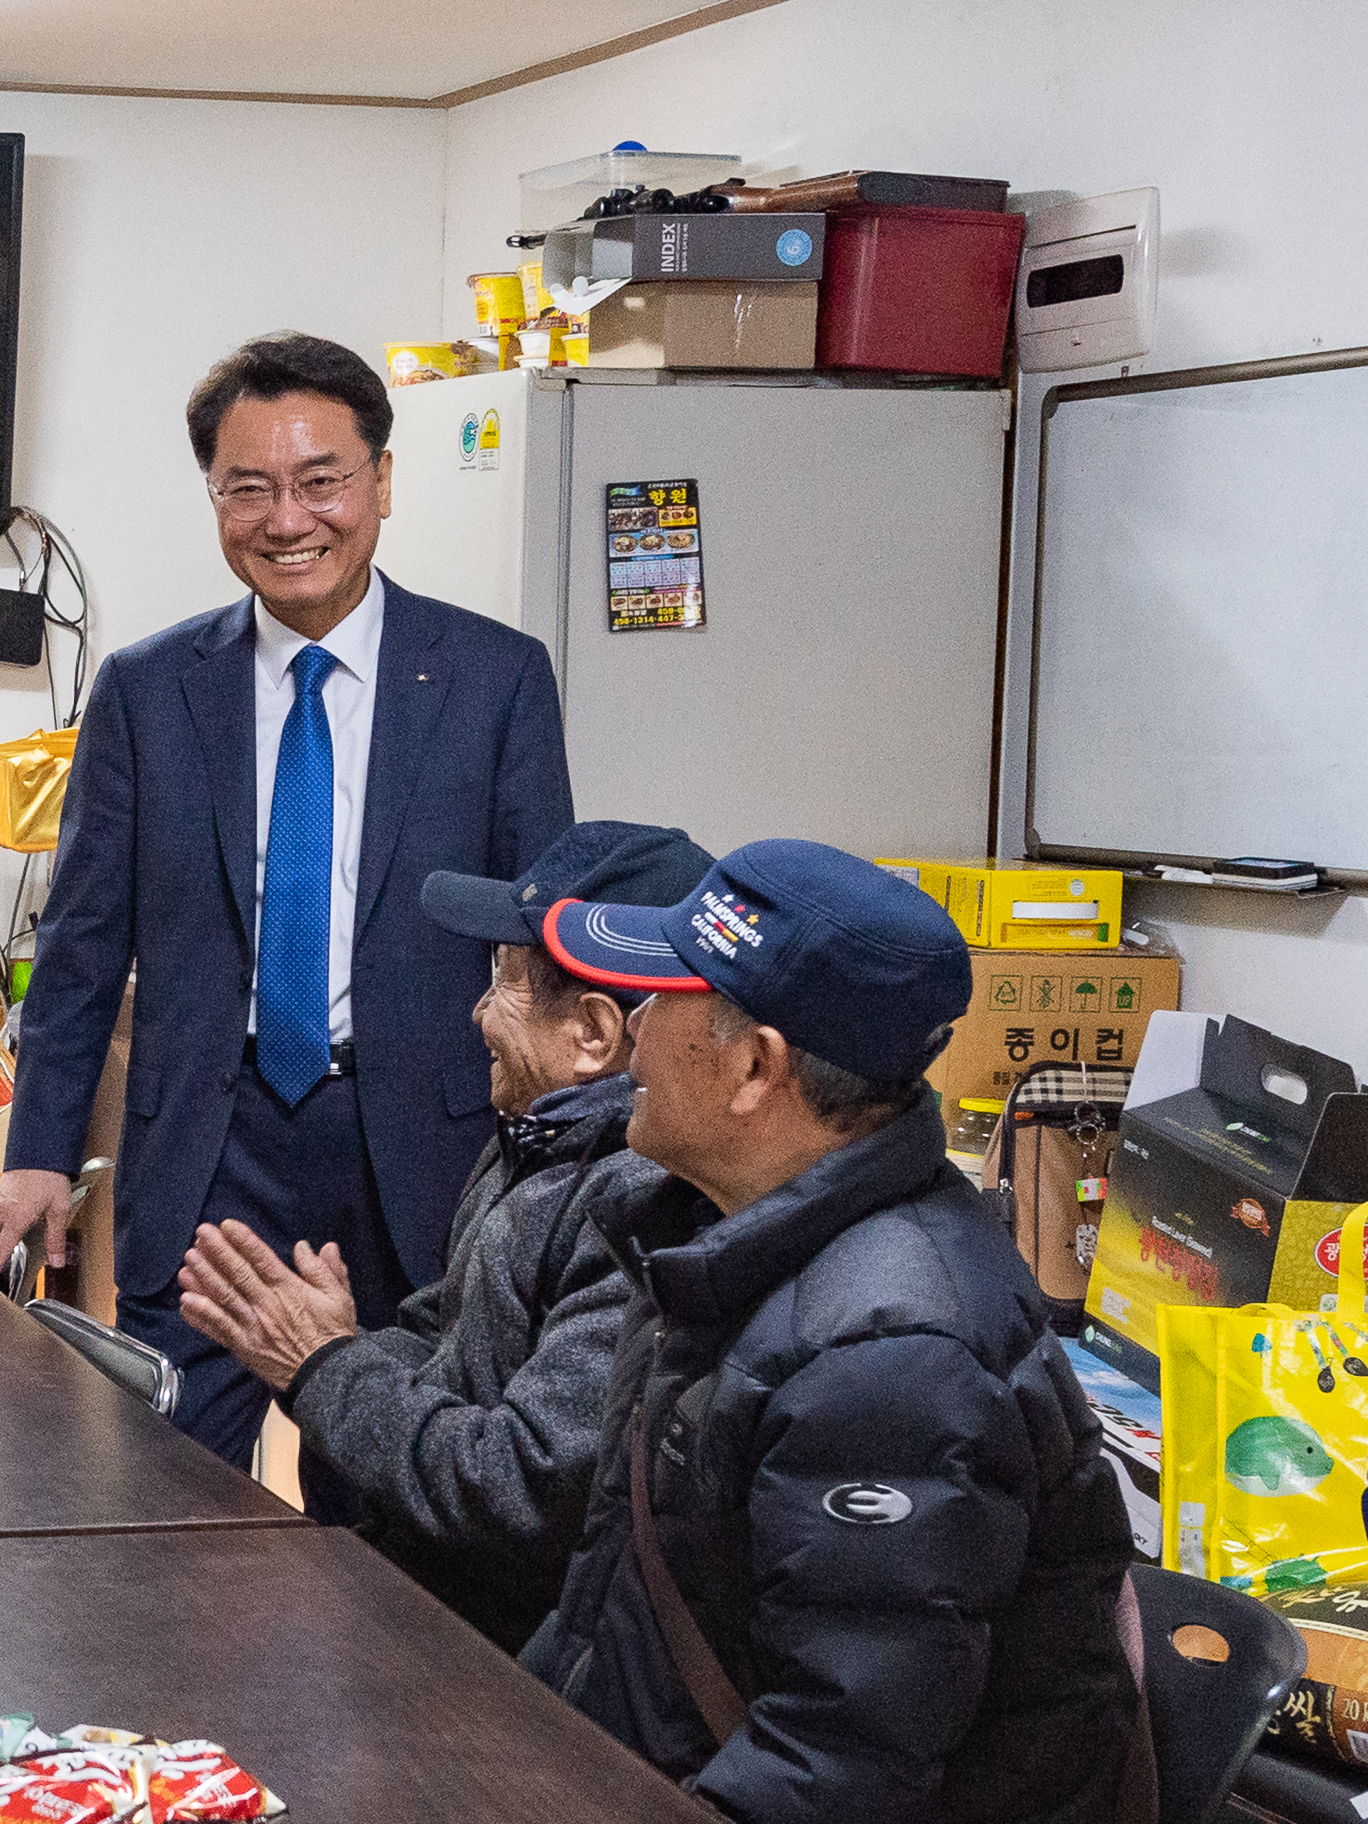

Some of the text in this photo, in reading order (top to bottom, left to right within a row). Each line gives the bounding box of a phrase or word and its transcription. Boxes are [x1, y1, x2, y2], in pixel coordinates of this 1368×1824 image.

[660, 222, 676, 273] INDEX
[691, 913, 738, 960] CALIFORNIA
[1004, 1027, 1124, 1062] 종이컵
